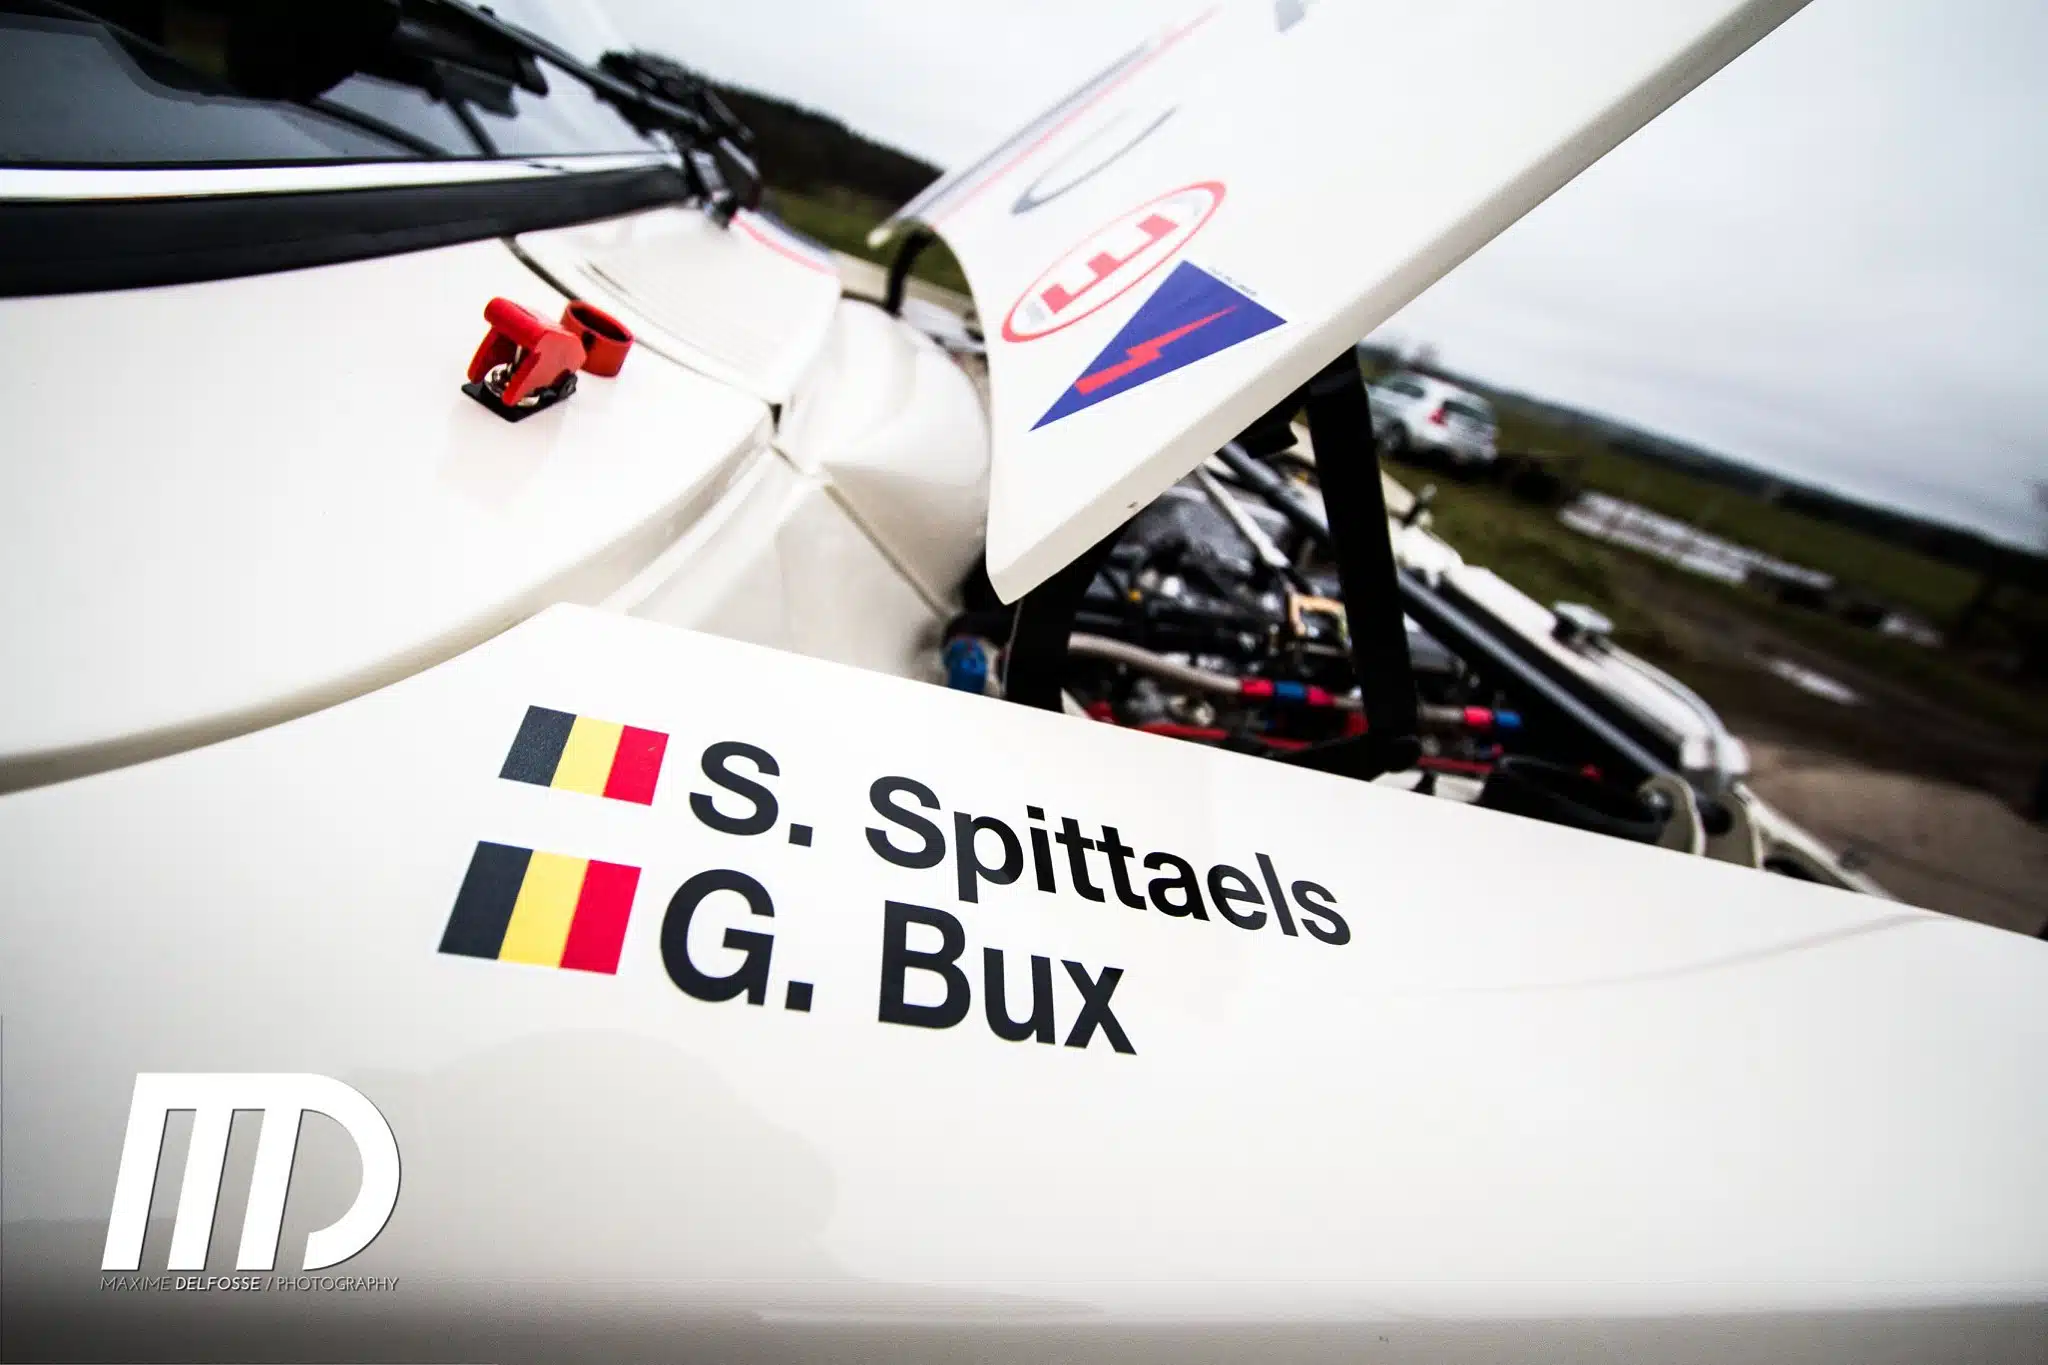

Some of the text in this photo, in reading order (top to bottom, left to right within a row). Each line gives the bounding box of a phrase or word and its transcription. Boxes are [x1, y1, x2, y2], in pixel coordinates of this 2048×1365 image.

[689, 741, 1351, 946] S. Spittaels
[660, 868, 1137, 1056] G. Bux
